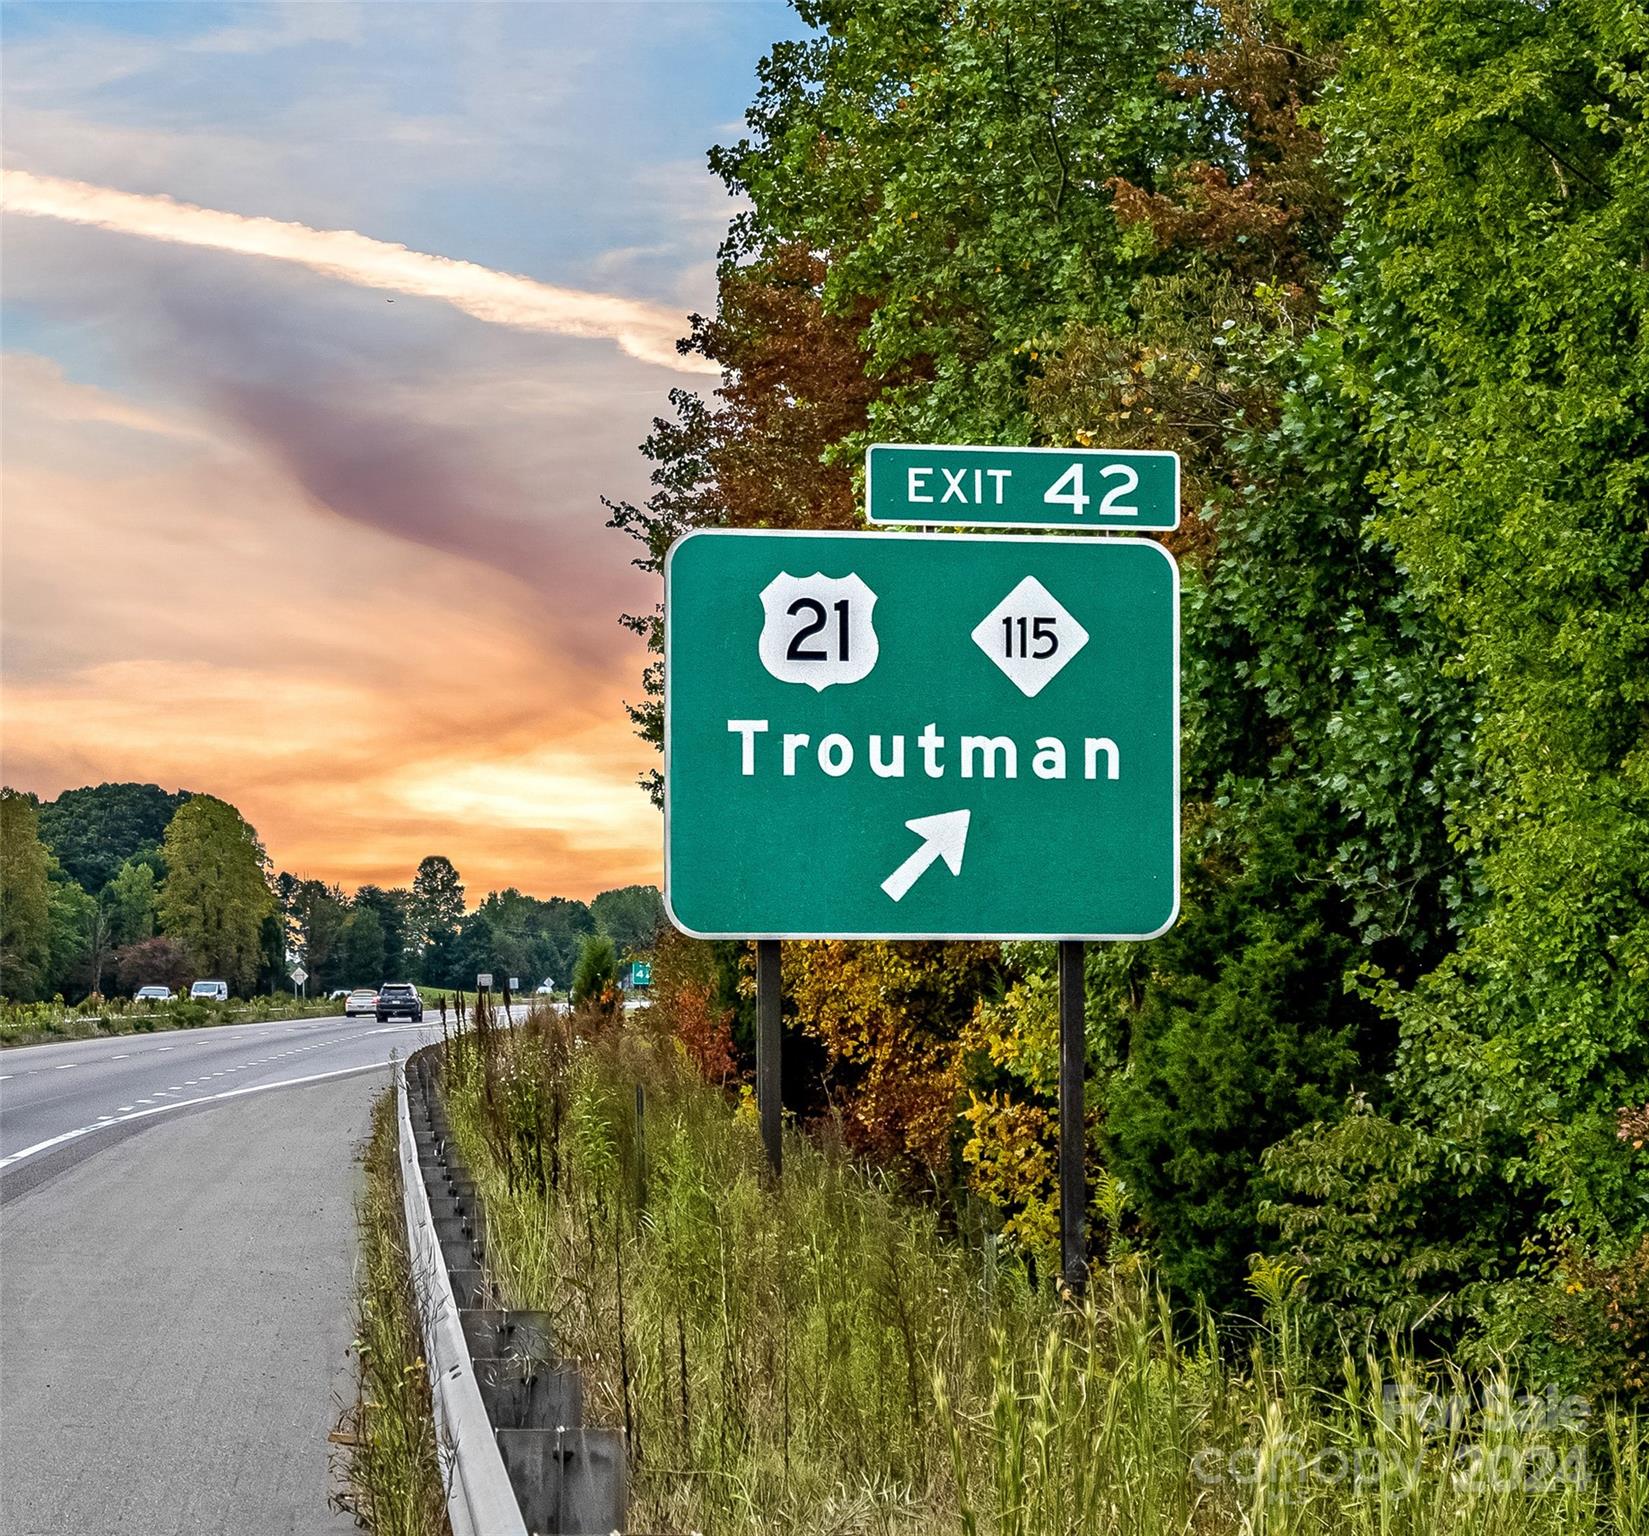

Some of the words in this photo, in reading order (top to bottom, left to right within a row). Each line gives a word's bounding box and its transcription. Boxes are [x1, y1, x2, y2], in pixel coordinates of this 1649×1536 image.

[907, 467, 1012, 505] EXIT
[1043, 463, 1140, 517] 42
[786, 597, 850, 662] 21
[1001, 616, 1060, 660] 115
[727, 720, 1120, 781] Troutman
